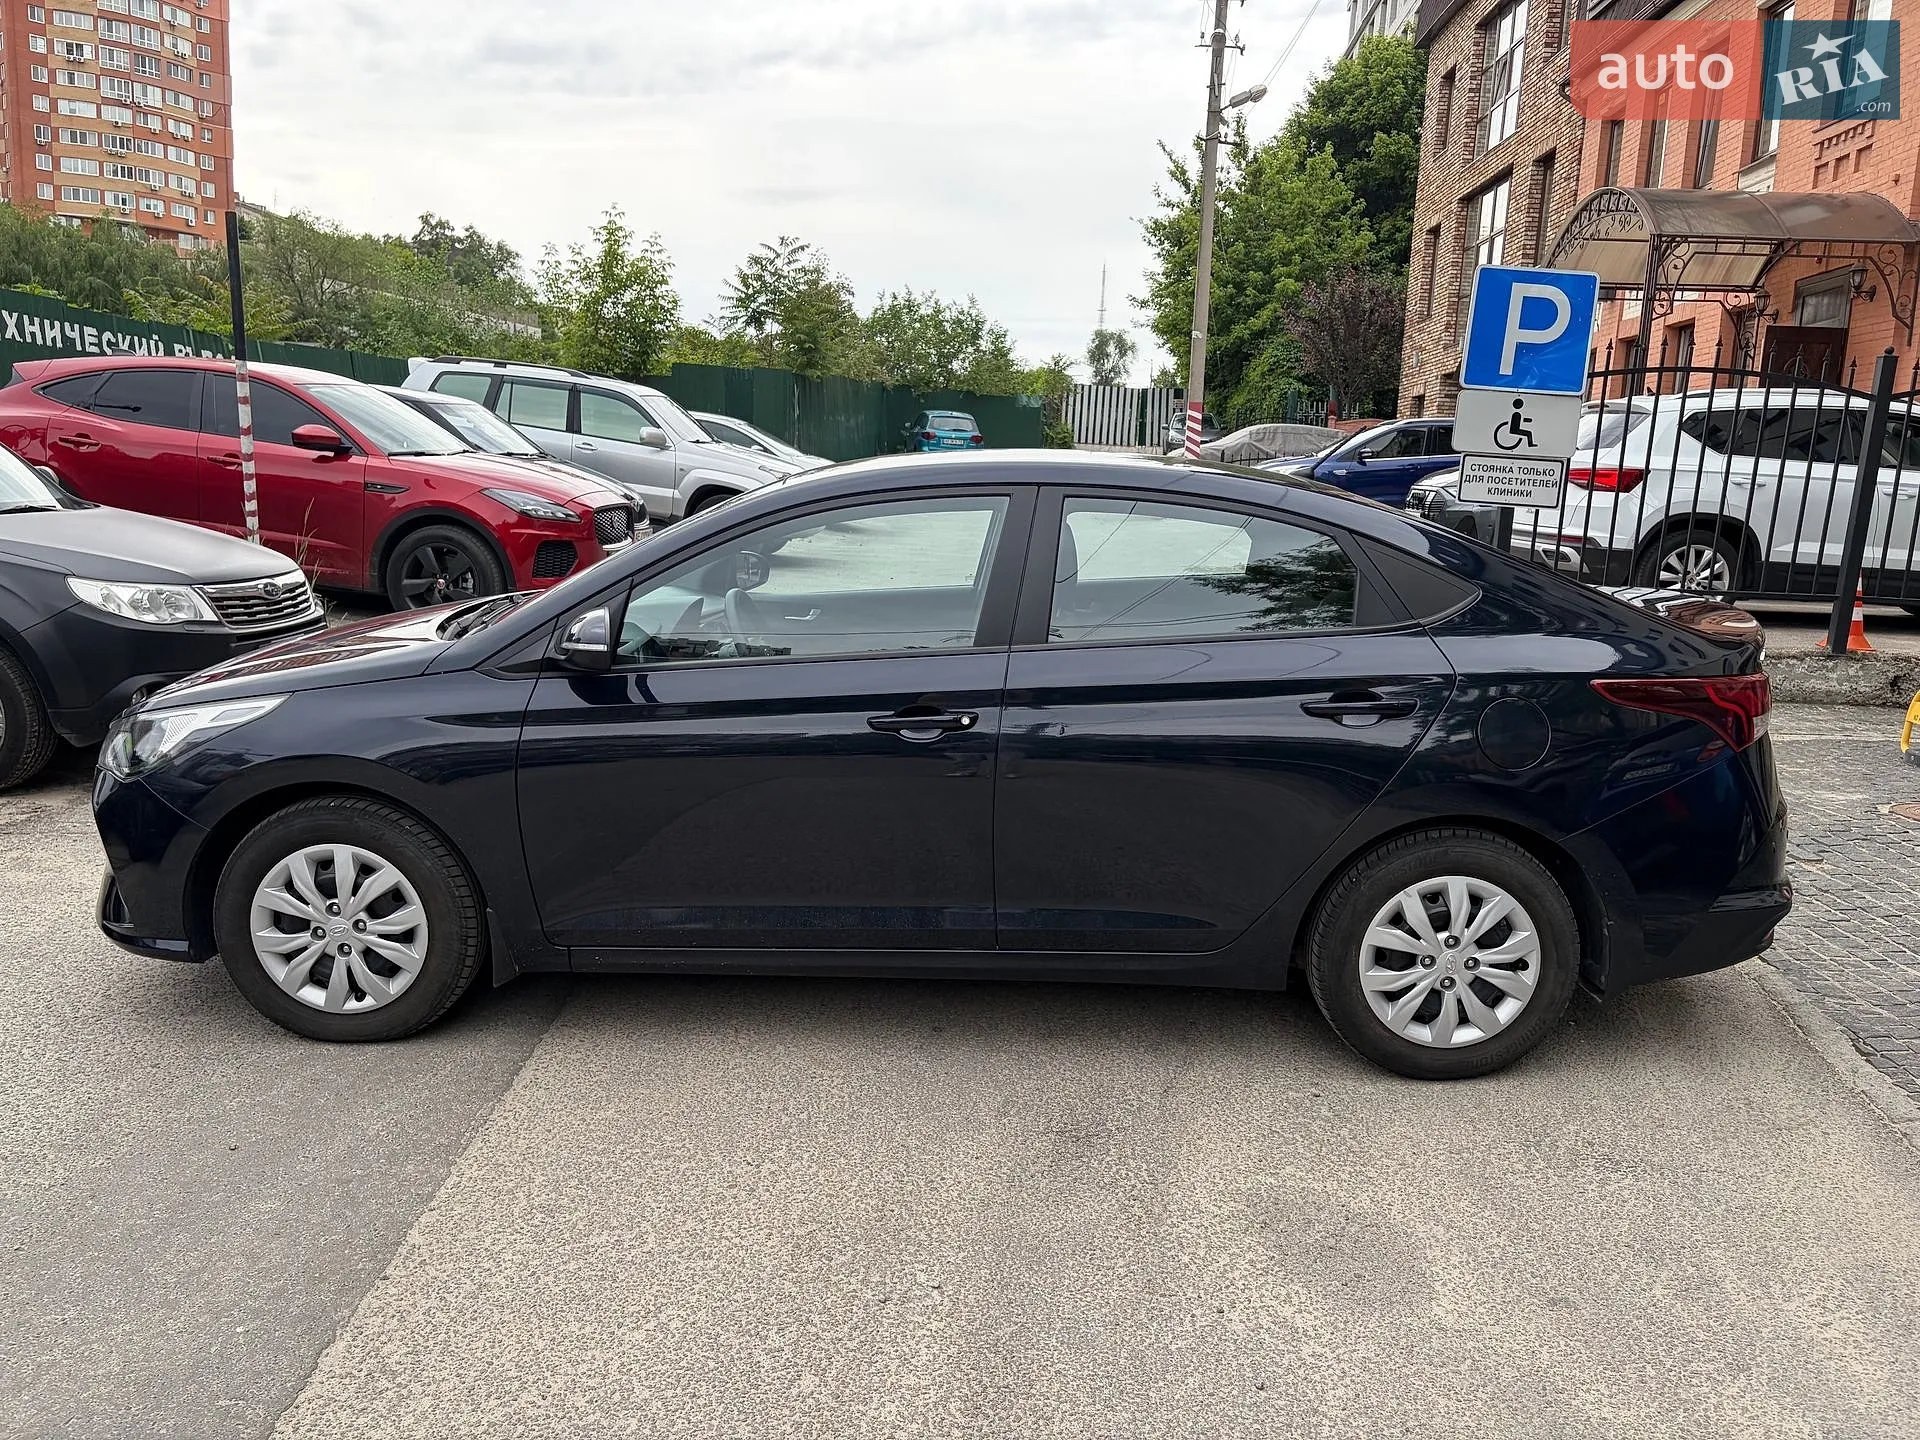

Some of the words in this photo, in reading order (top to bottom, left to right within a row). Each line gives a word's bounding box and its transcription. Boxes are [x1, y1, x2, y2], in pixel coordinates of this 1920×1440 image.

[0, 310, 164, 357] ХНИЧЕСКИЙ
[1499, 282, 1572, 376] P
[1470, 463, 1514, 474] СТОЯНКА
[1518, 467, 1555, 477] ТОЛЬКО
[1463, 474, 1485, 484] ДЛЯ
[1486, 476, 1558, 488] ПОСЕТИТЕЛЕЙ
[1487, 487, 1532, 498] КЛИНИКИ
